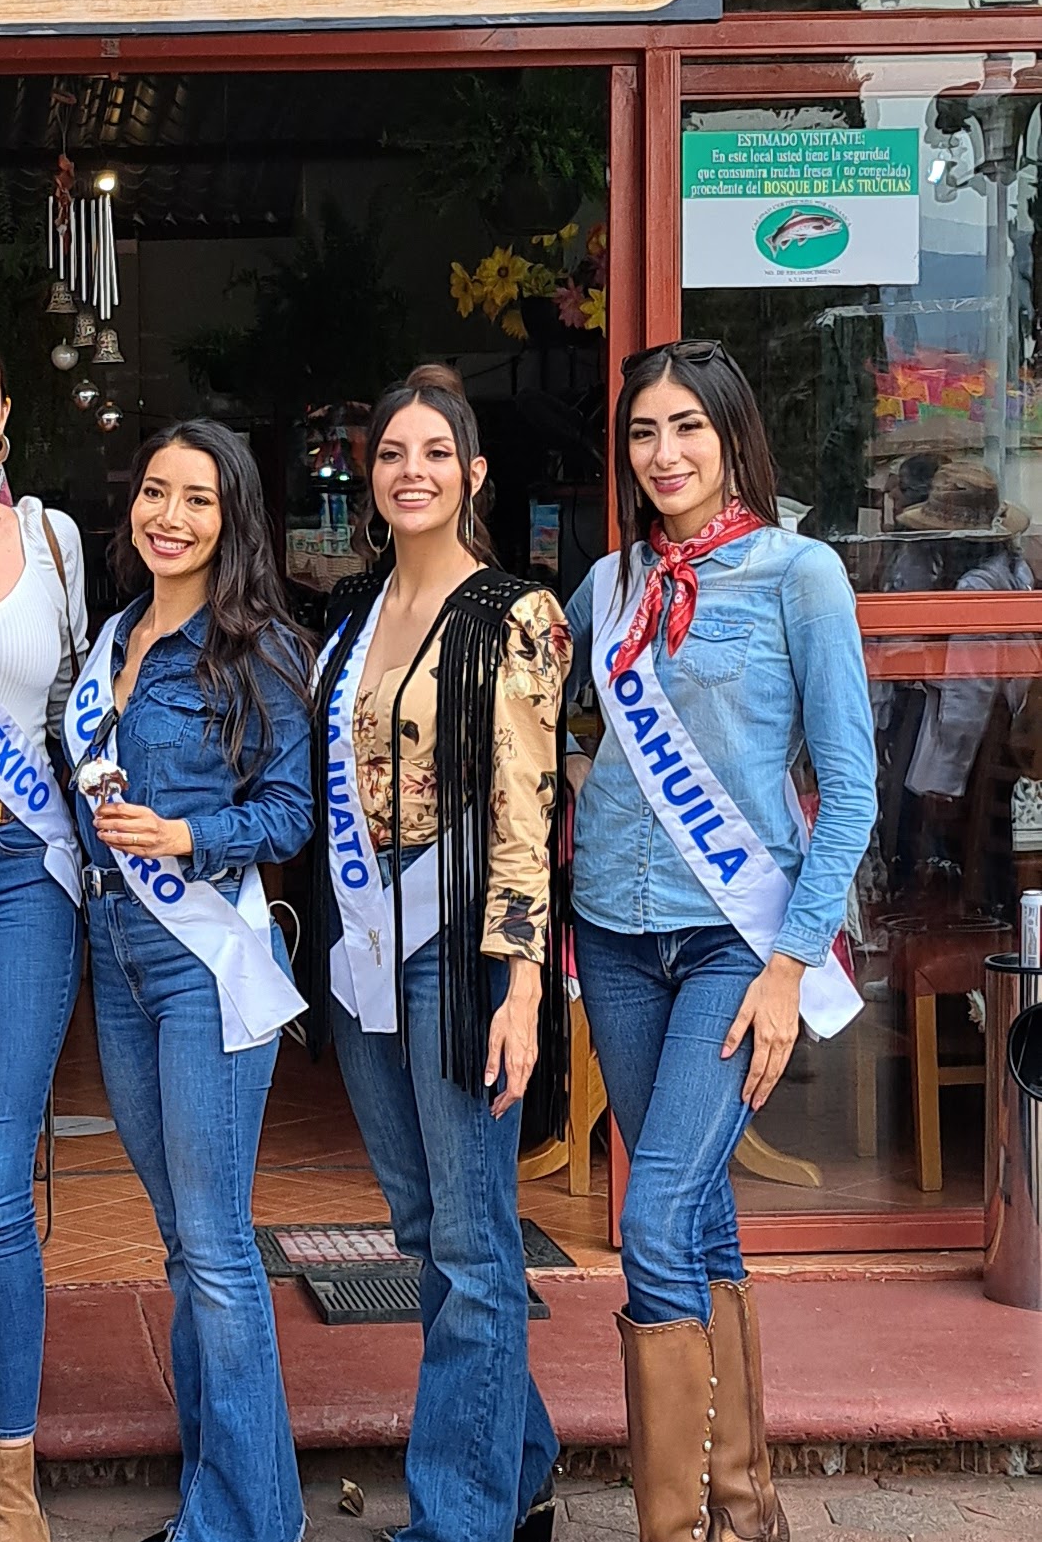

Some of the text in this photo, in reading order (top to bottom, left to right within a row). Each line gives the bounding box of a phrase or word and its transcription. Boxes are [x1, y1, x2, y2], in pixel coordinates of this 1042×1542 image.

[737, 133, 798, 147] ESTIMADO
[712, 147, 890, 164] En este local usted tiene la seguridad
[697, 168, 715, 182] que
[770, 165, 801, 178] trucha
[803, 164, 832, 177] fresca
[691, 178, 911, 198] procedente del BOSQUE DE LAS TRUCHAS
